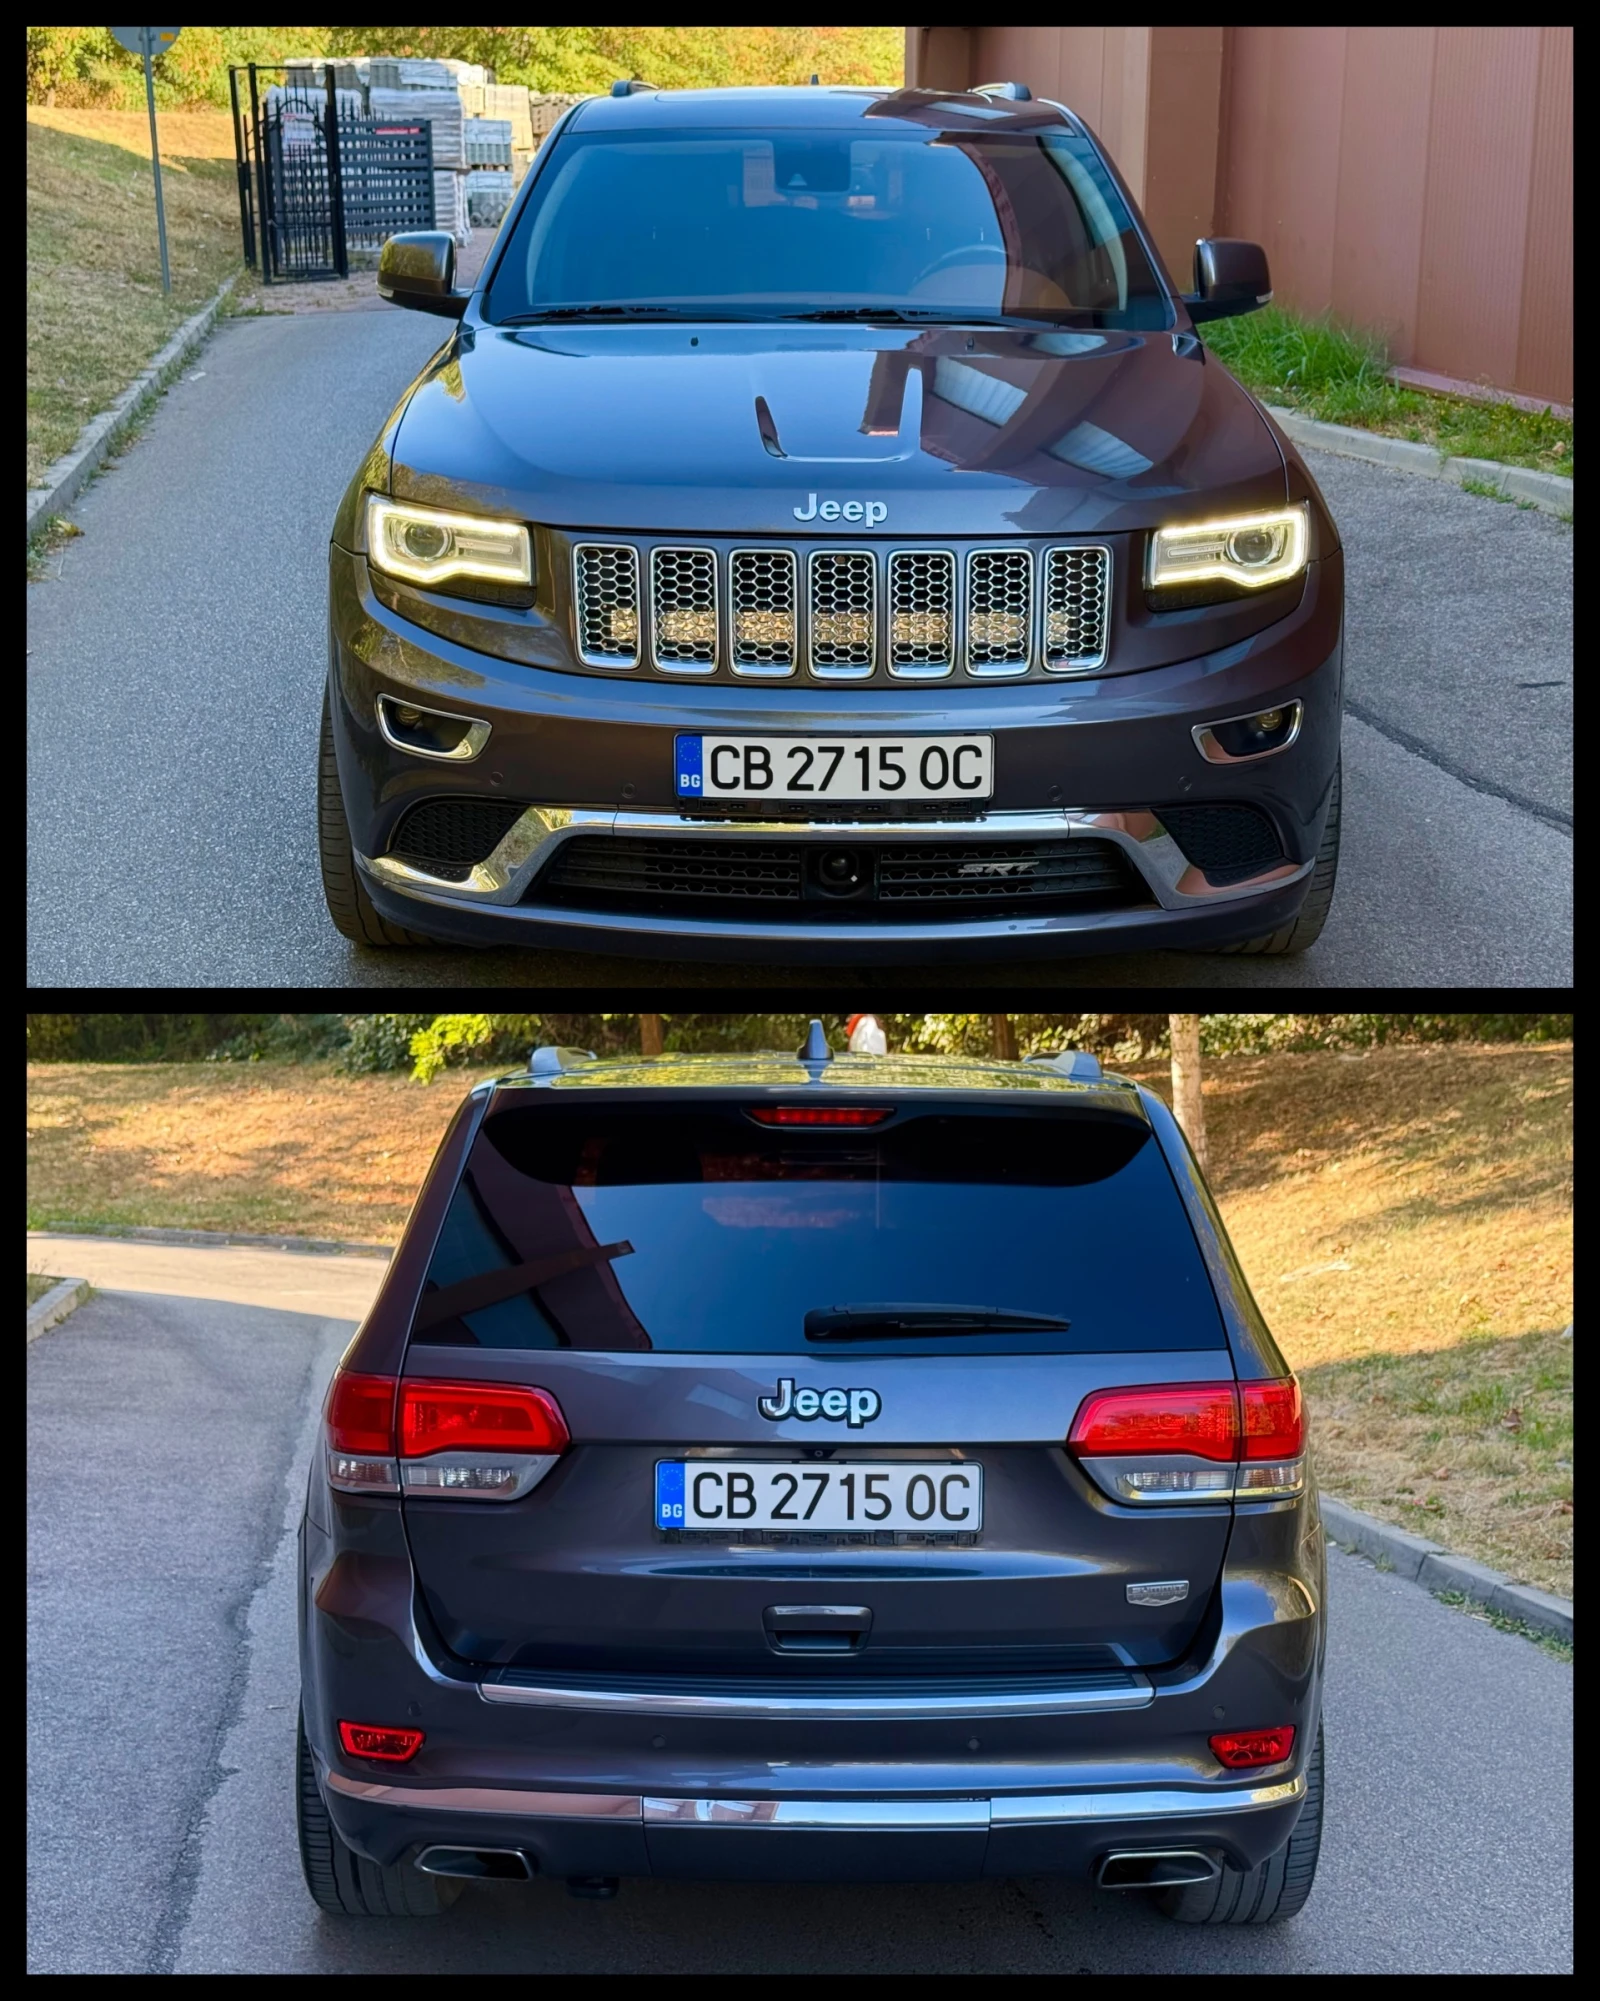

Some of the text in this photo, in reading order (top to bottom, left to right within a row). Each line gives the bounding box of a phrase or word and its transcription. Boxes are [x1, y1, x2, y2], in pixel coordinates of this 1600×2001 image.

[793, 493, 888, 528] Jeep
[681, 774, 701, 788] BG
[710, 744, 774, 791] CB
[786, 745, 907, 792] 2715
[958, 861, 1040, 877] SRT
[760, 1379, 879, 1426] Jeep
[661, 1503, 683, 1518] BG
[693, 1472, 757, 1519] CB
[770, 1473, 892, 1521] 2715
